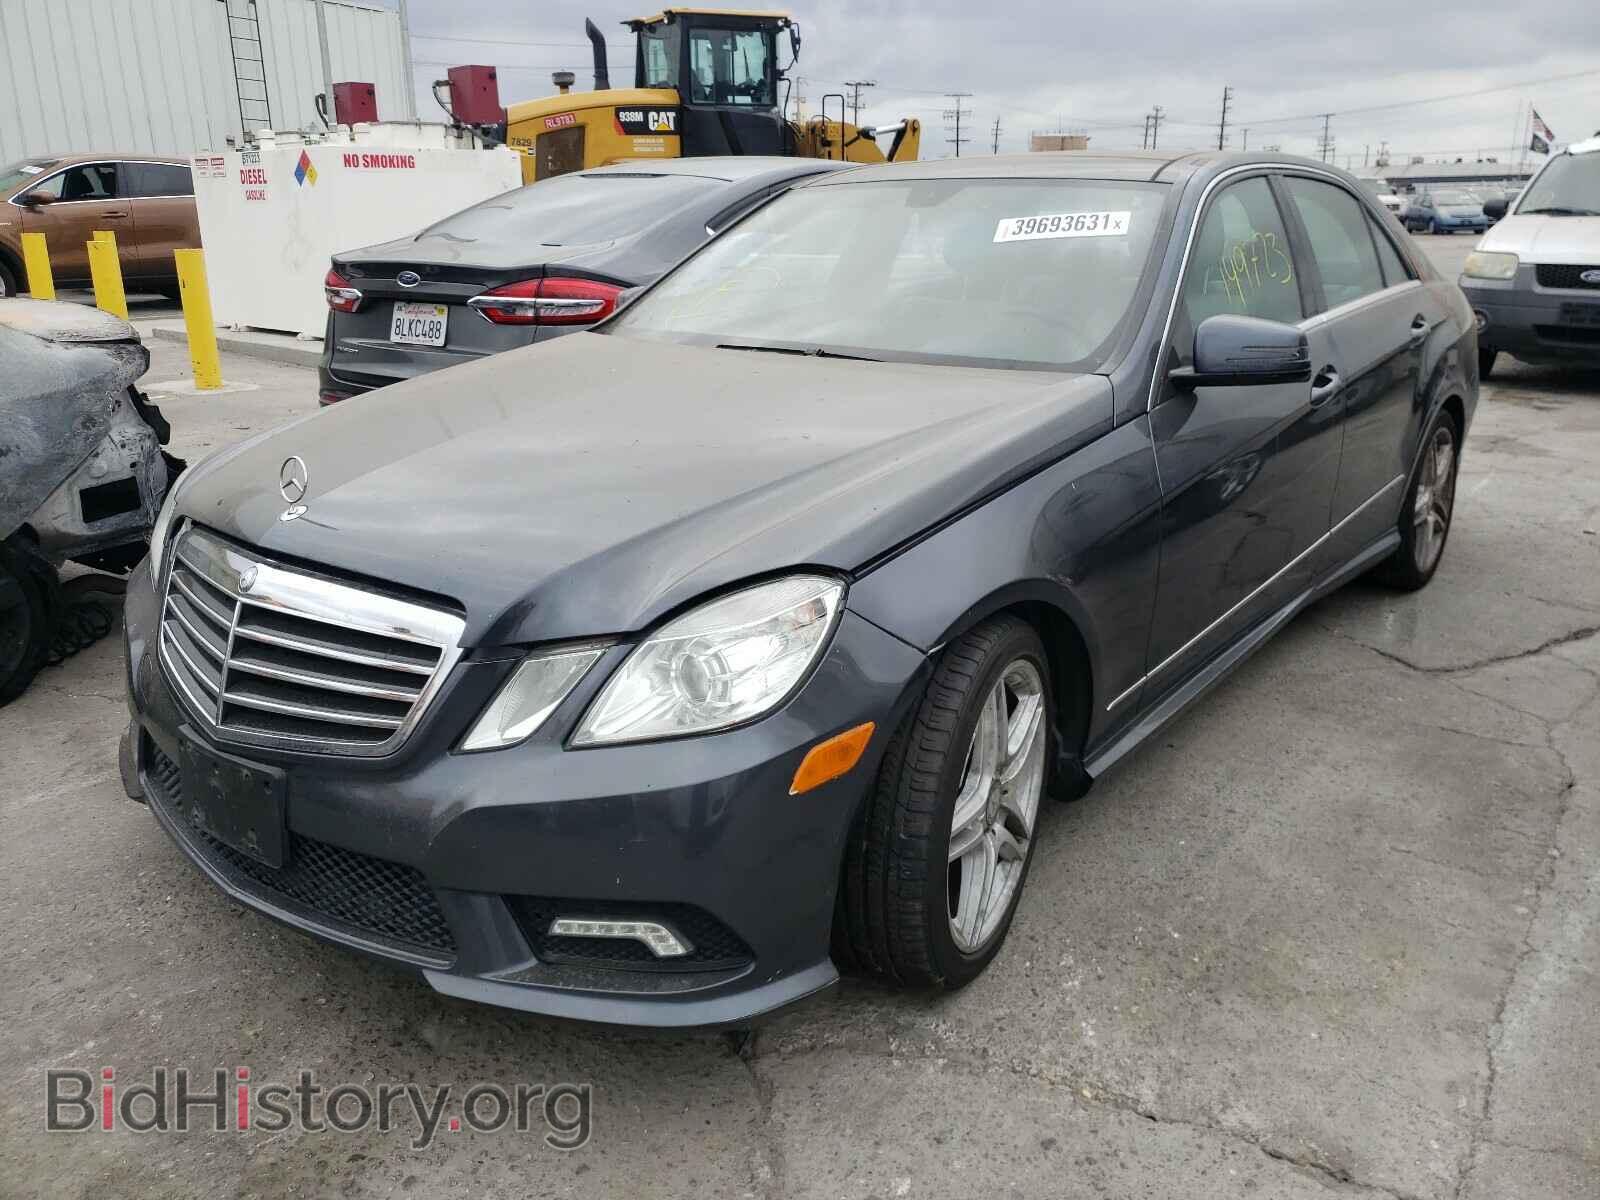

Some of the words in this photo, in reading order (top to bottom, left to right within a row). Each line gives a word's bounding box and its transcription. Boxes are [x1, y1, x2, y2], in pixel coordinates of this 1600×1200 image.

[619, 111, 644, 122] 938M
[648, 111, 676, 131] CAT
[343, 153, 359, 168] NO
[362, 153, 415, 168] SMOKING
[240, 169, 267, 184] DIESEL
[1012, 213, 1111, 236] 39693631
[395, 318, 442, 339] 8LKC488
